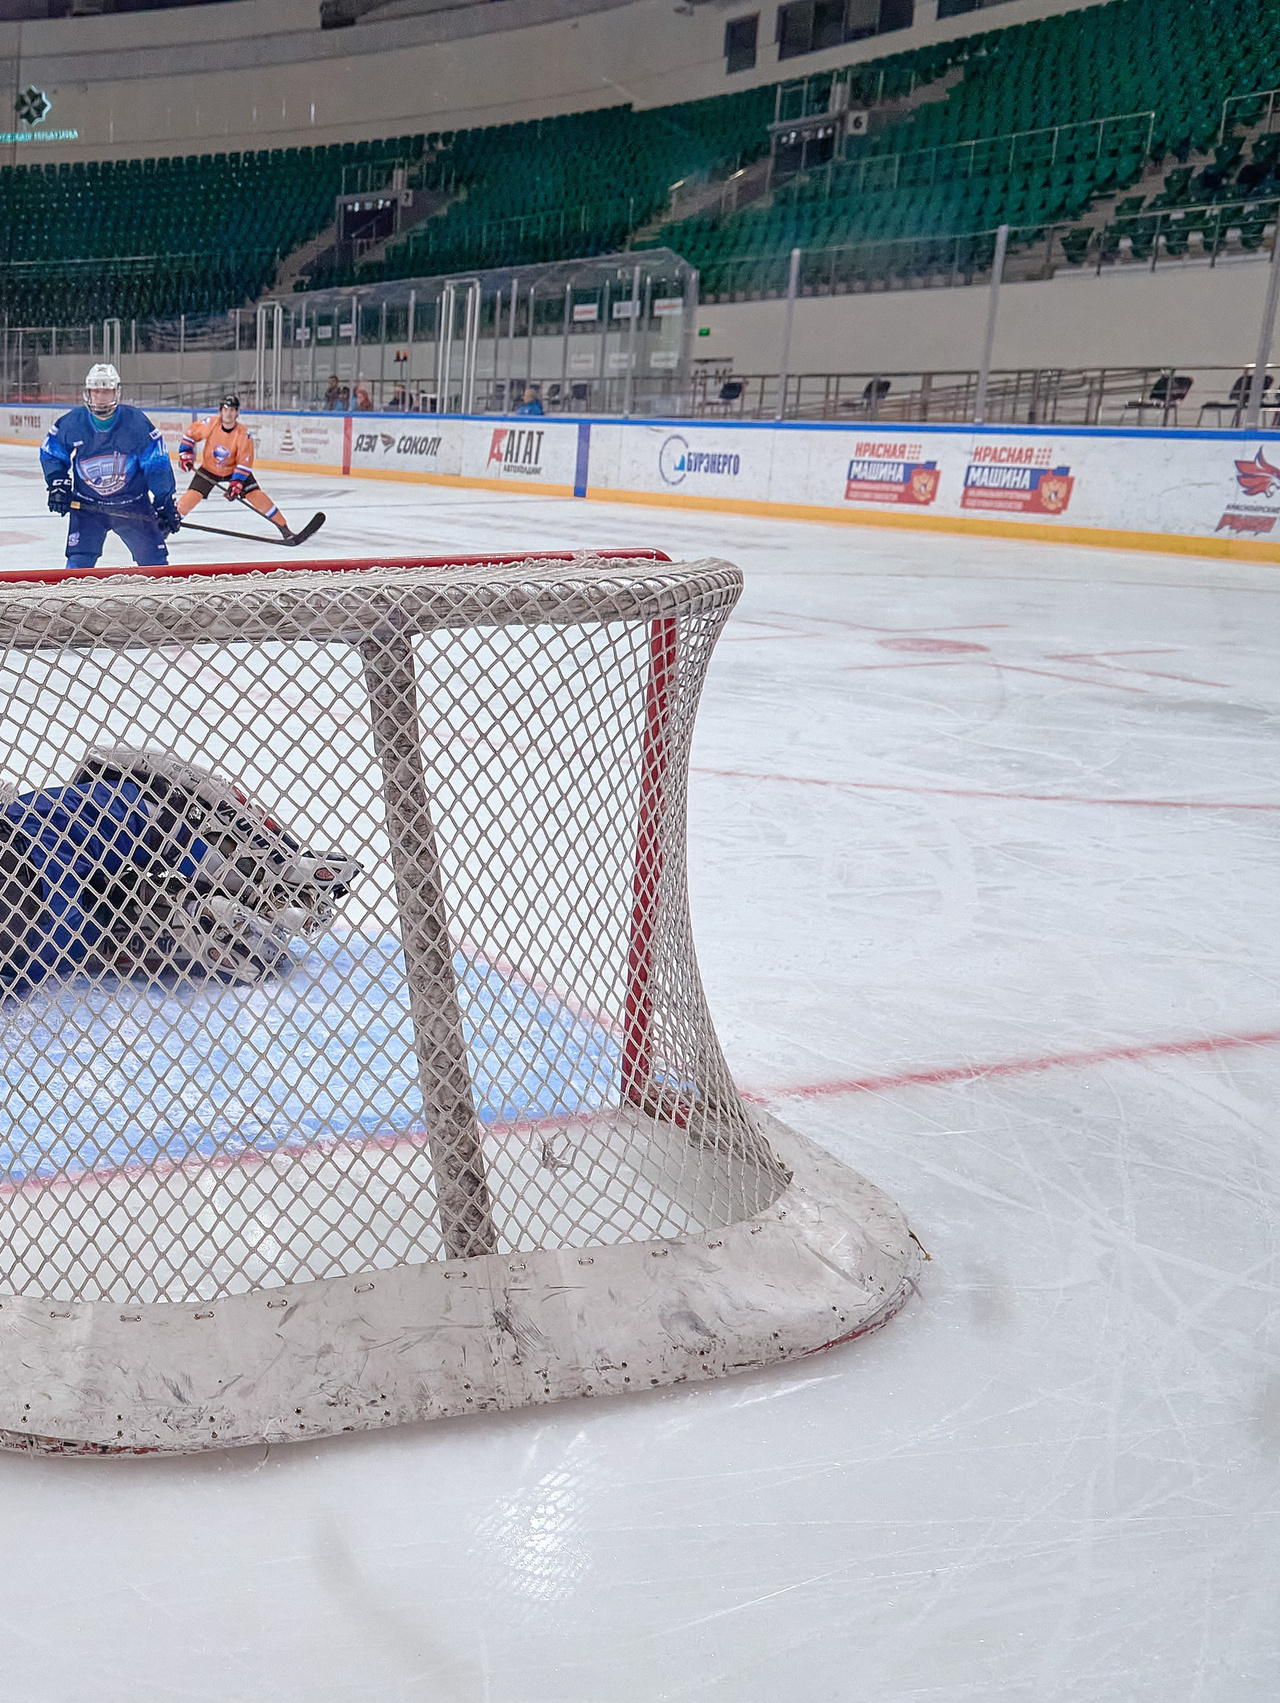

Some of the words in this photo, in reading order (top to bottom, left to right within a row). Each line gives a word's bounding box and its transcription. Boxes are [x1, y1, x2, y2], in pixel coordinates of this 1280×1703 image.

[397, 434, 442, 457] СОКОЛ!
[504, 429, 545, 466] АГАТ
[854, 441, 908, 460] КРАСНАЯ
[972, 445, 1035, 465] КРАСНАЯ
[686, 451, 741, 476] БУРЭНЕРГО
[849, 461, 905, 483] МАШИНА
[966, 465, 1031, 490] МАШИНА
